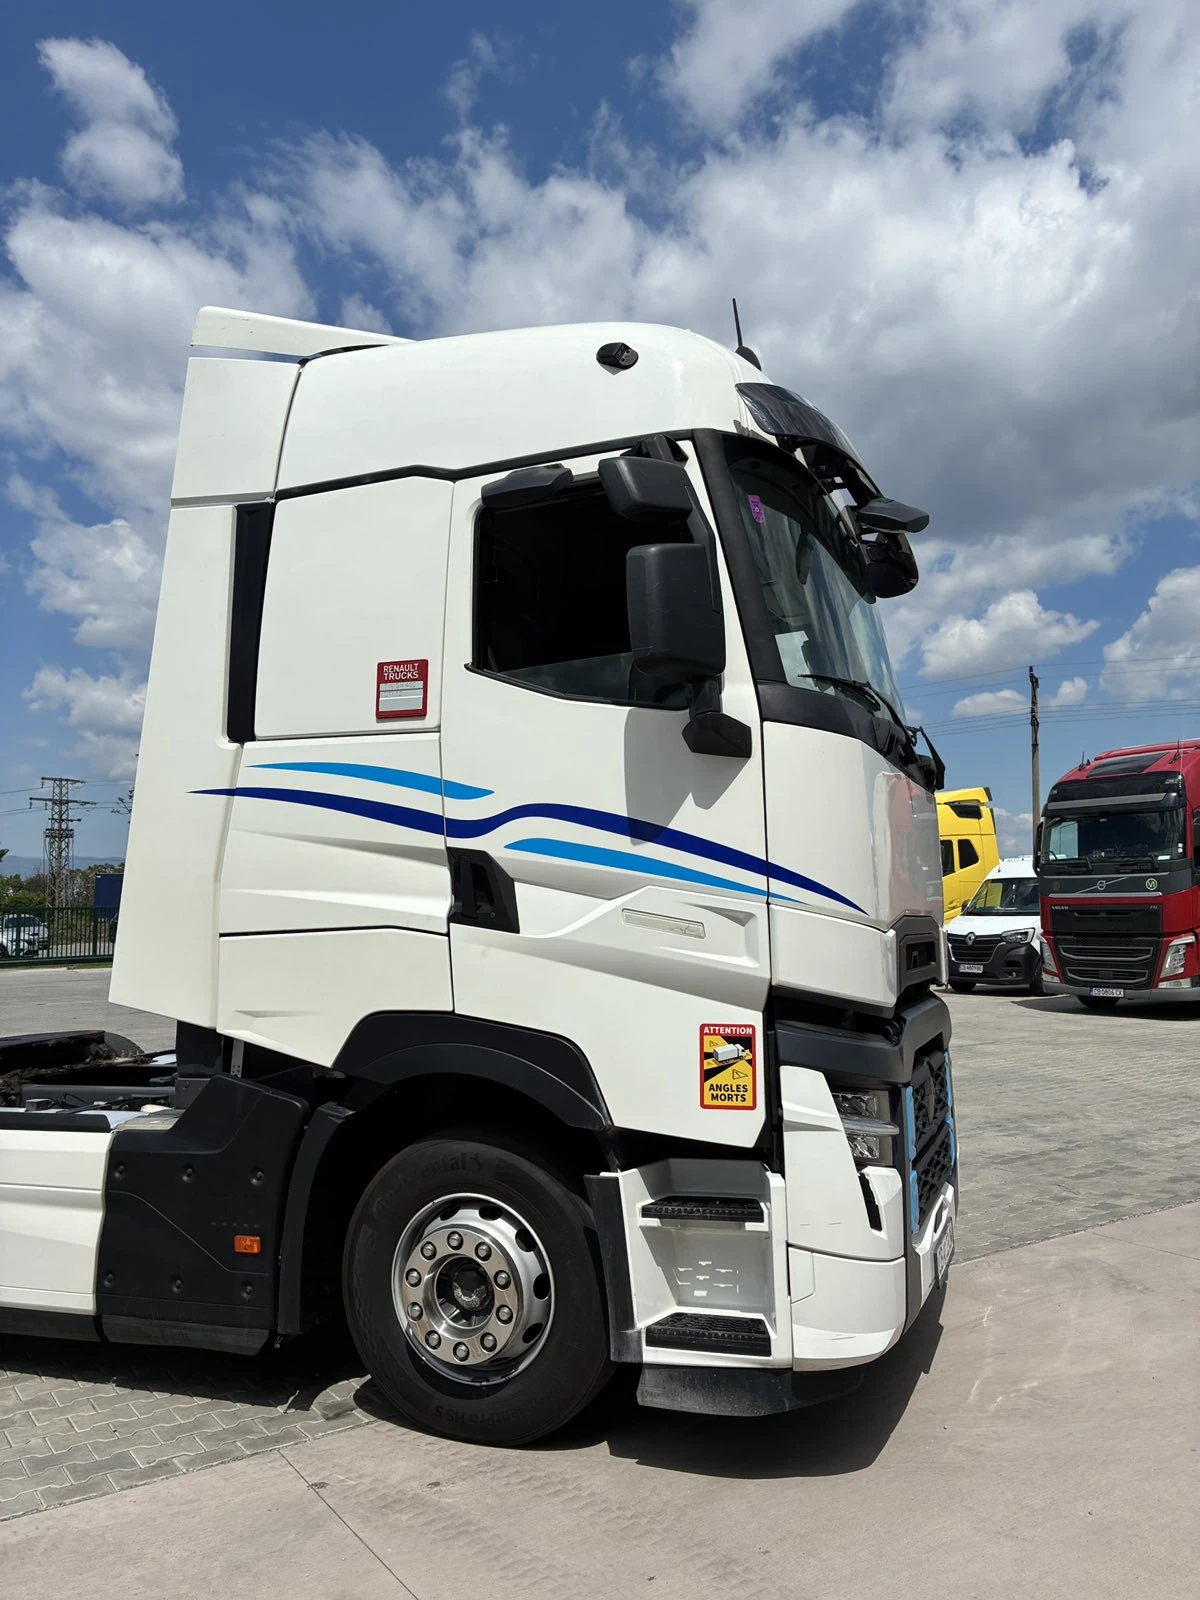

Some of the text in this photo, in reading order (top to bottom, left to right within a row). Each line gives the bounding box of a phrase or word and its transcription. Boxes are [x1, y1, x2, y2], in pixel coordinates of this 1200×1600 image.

[384, 663, 419, 673] RENAULT
[384, 671, 419, 680] TRUCKS
[704, 1026, 752, 1034] ATTENTION
[709, 1083, 748, 1092] ANGLES
[711, 1093, 747, 1102] MORTS
